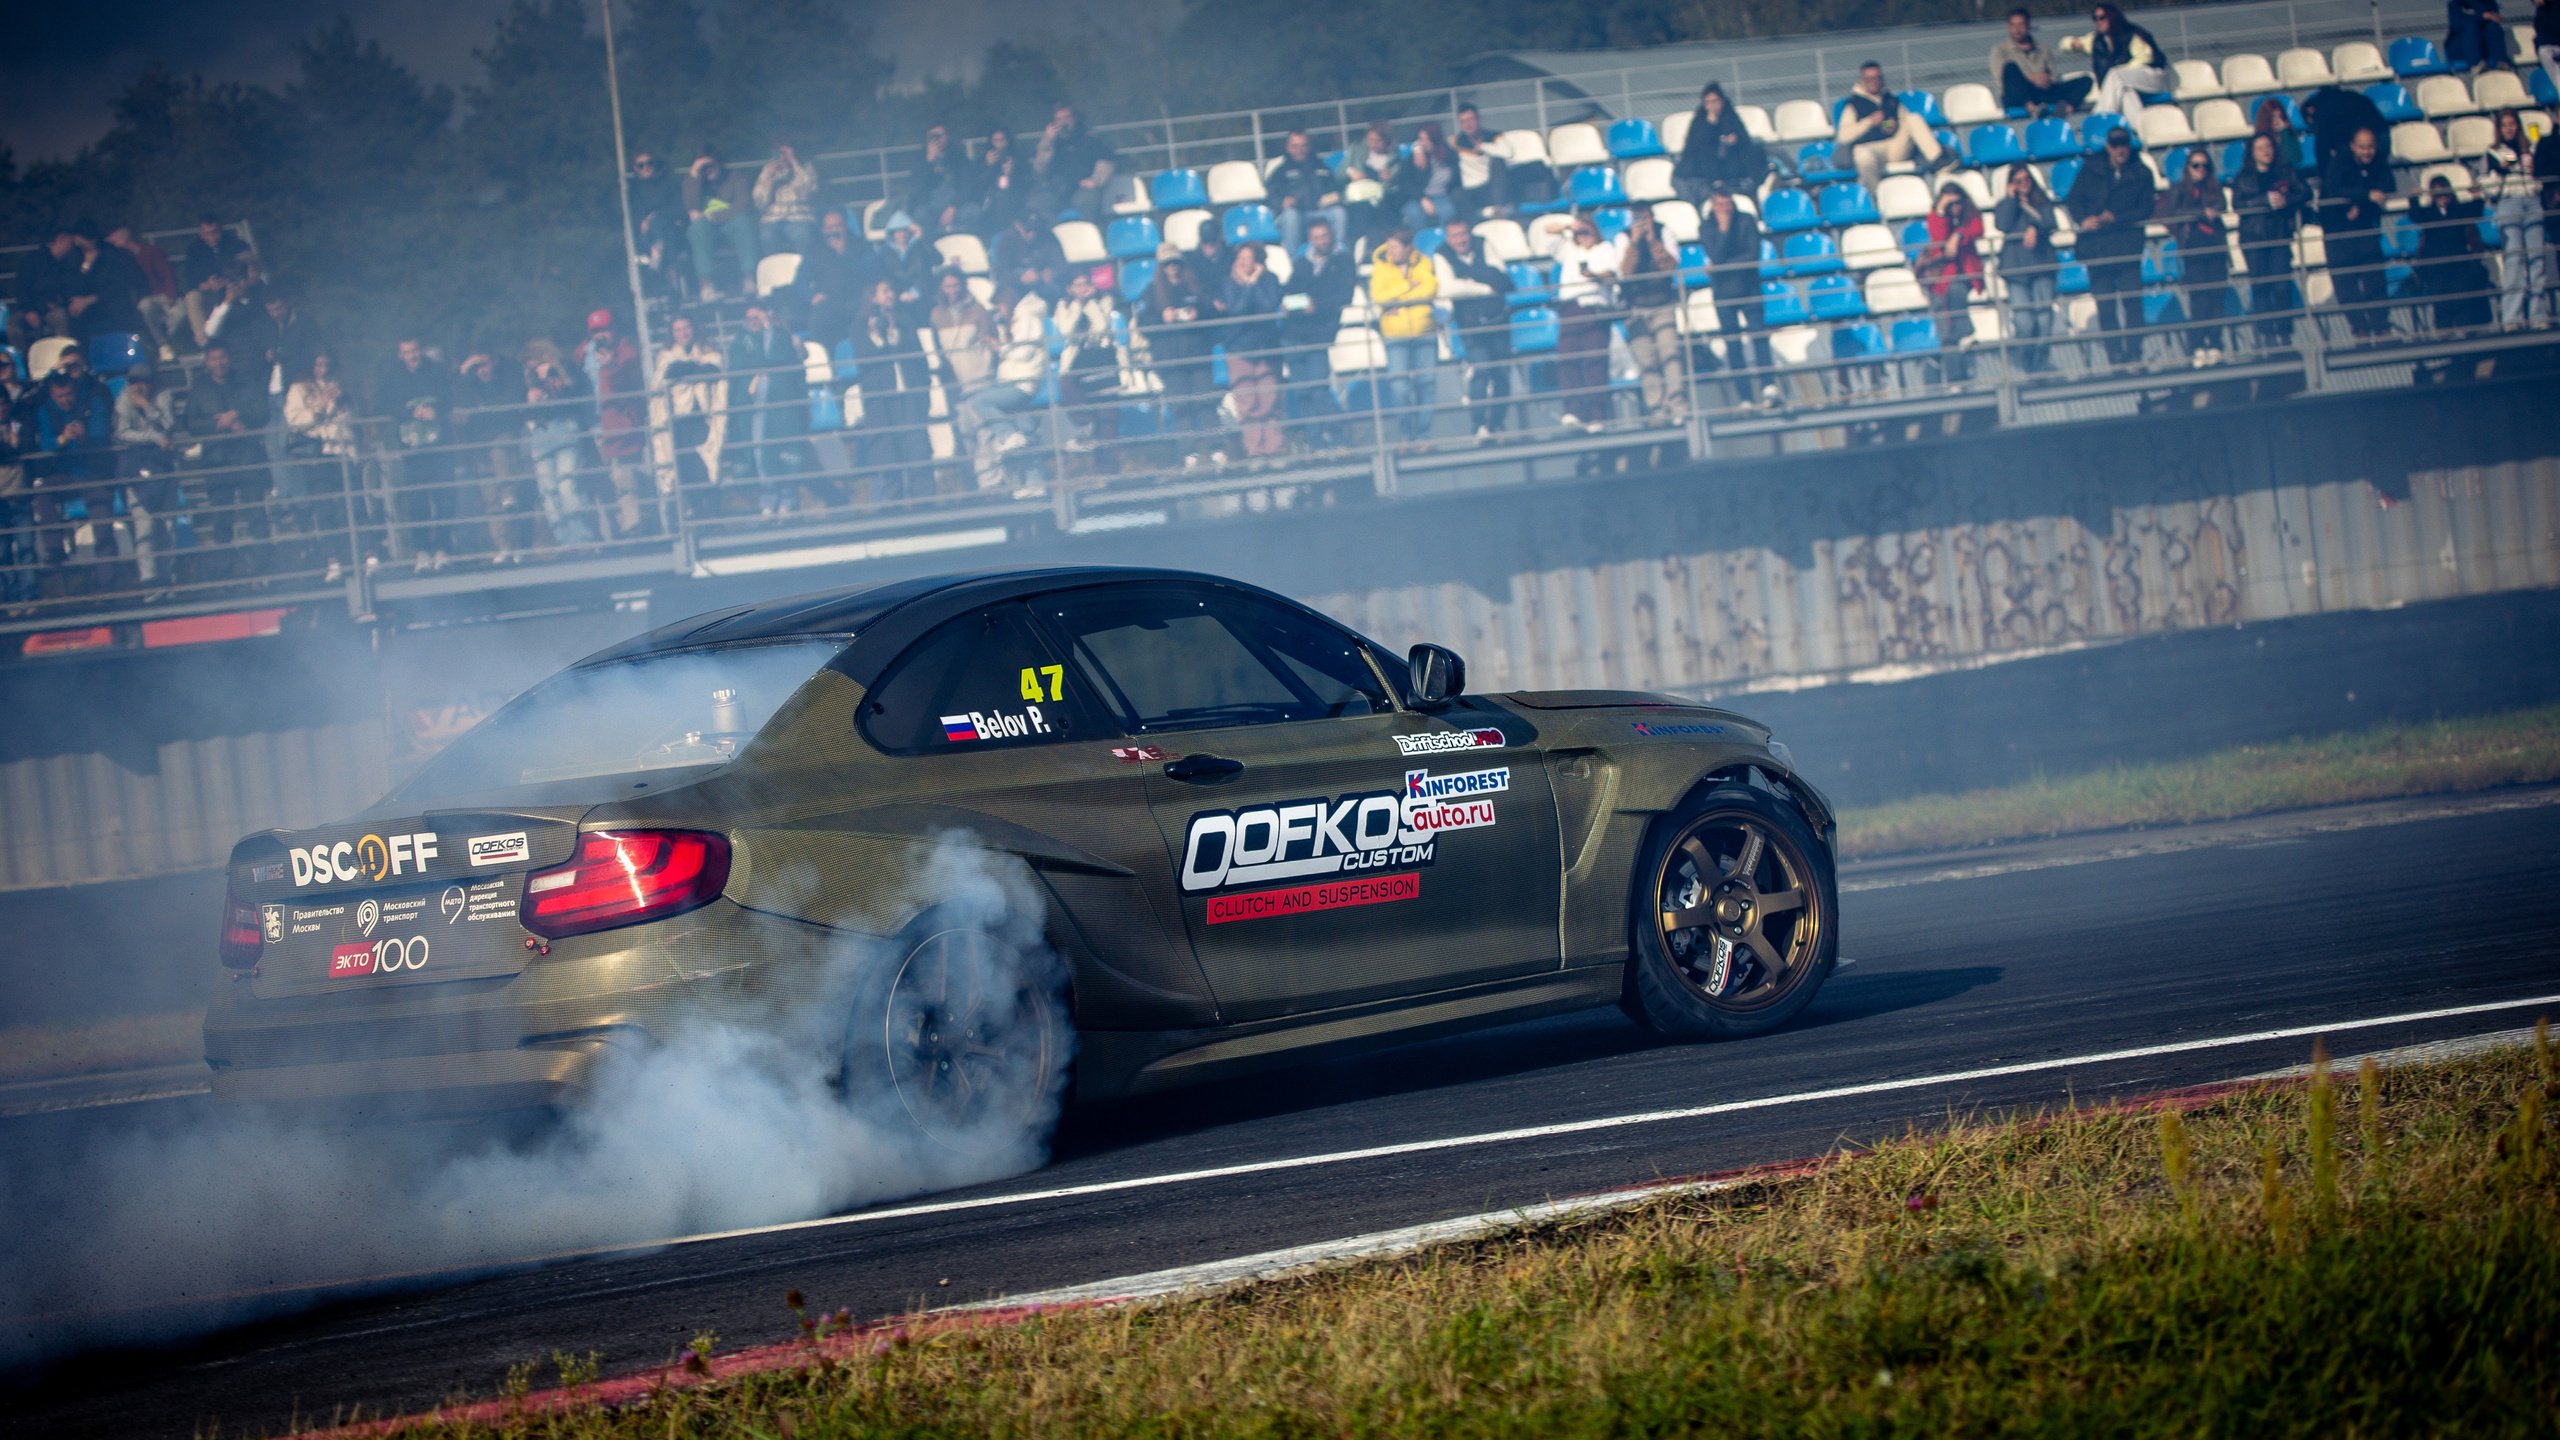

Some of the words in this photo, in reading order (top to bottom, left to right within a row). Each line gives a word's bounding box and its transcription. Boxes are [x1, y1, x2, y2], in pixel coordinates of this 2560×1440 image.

[1020, 664, 1064, 703] 47
[969, 709, 1029, 740] Belov
[1026, 706, 1051, 734] P.
[1631, 722, 1726, 736] KINFOREST
[1408, 771, 1507, 799] KINFOREST
[1413, 803, 1493, 831] auto.ru
[472, 837, 524, 855] OOFKOS
[1343, 844, 1434, 871] CUSTOM
[383, 898, 426, 911] Московский
[469, 892, 497, 903] дирекция
[1214, 897, 1275, 918] CLUTCH
[1282, 891, 1312, 911] AND
[1319, 878, 1415, 905] SUSPENSION
[293, 907, 345, 921] Правительство
[469, 900, 515, 912] транспортного
[383, 911, 418, 924] транспорт
[467, 910, 516, 921] обслуживания
[292, 923, 320, 934] Москвы
[335, 952, 369, 970] ЭКТО
[372, 935, 429, 974] 100
